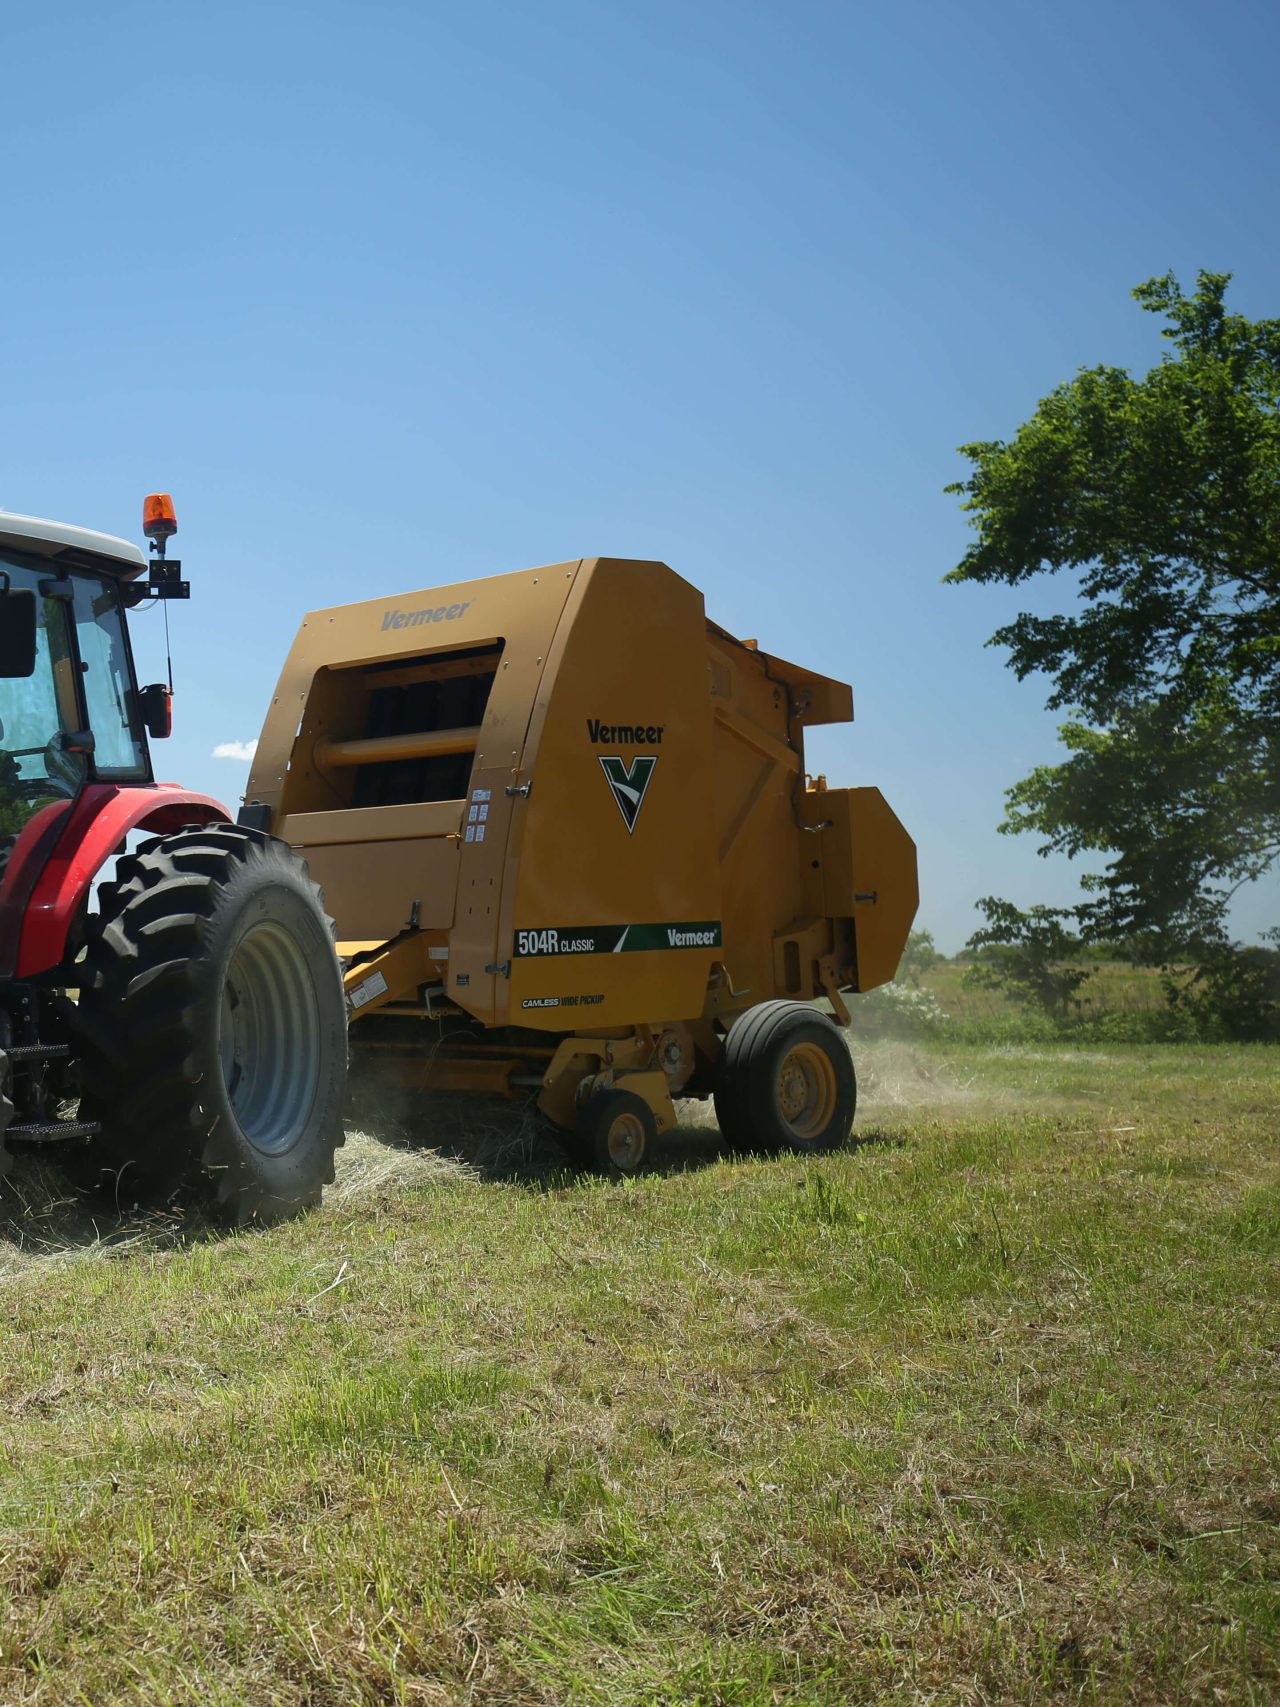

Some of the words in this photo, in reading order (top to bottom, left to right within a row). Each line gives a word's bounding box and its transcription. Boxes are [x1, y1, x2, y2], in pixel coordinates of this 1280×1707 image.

[381, 601, 470, 631] Vermeer
[586, 719, 664, 744] Vermeer
[519, 929, 559, 955] 504R
[560, 939, 595, 953] CLASSIC
[667, 929, 715, 946] Vermeer
[522, 998, 559, 1008] CAMLESS
[561, 996, 579, 1006] WIDE
[580, 994, 605, 1005] PICKUP
